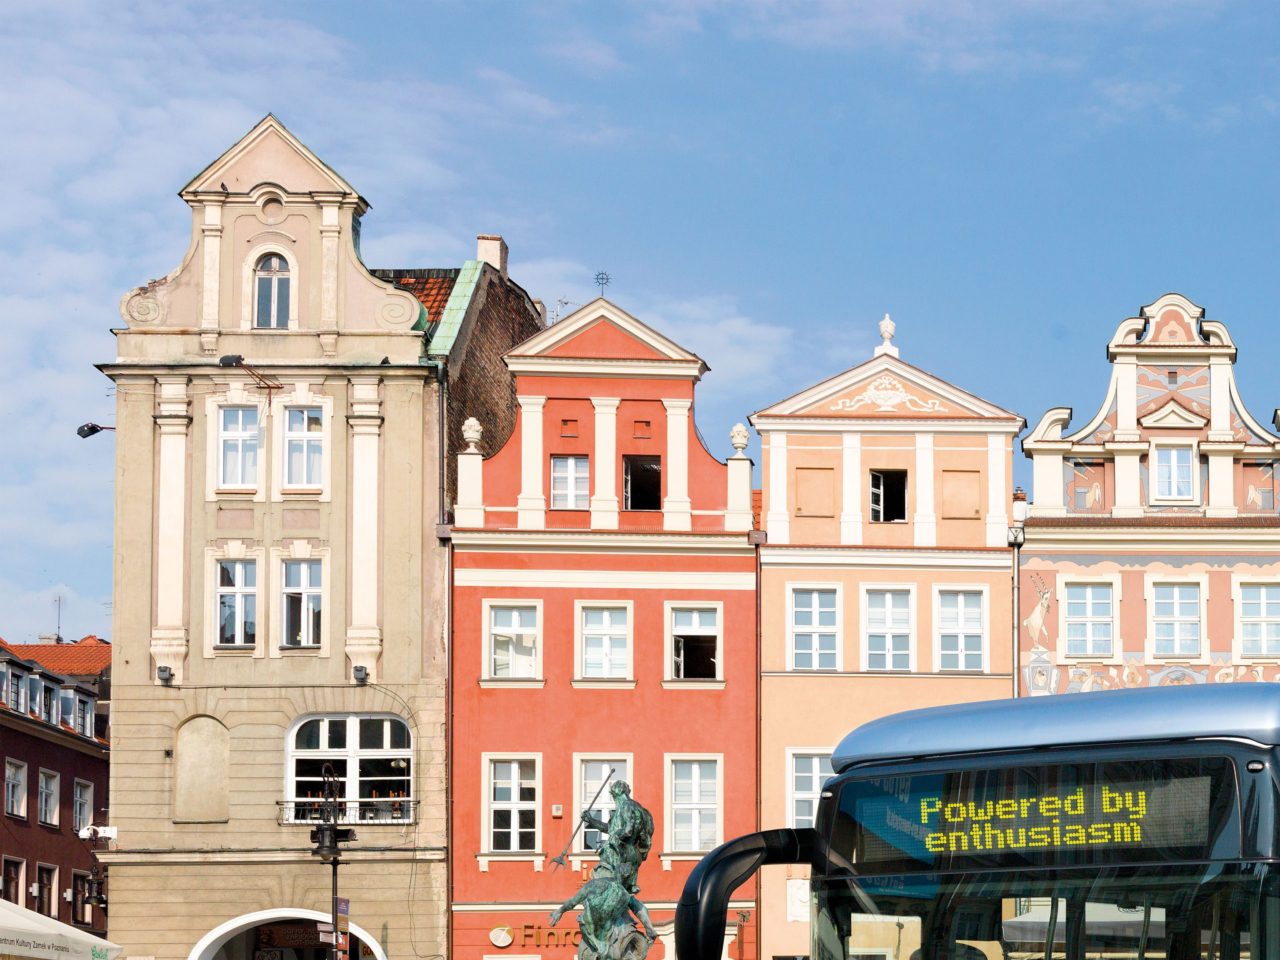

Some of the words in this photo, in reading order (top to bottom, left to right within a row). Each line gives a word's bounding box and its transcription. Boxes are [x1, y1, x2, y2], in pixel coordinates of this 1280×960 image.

[920, 788, 1085, 824] Powered
[1102, 786, 1147, 819] by
[925, 819, 1142, 852] enthusiasm
